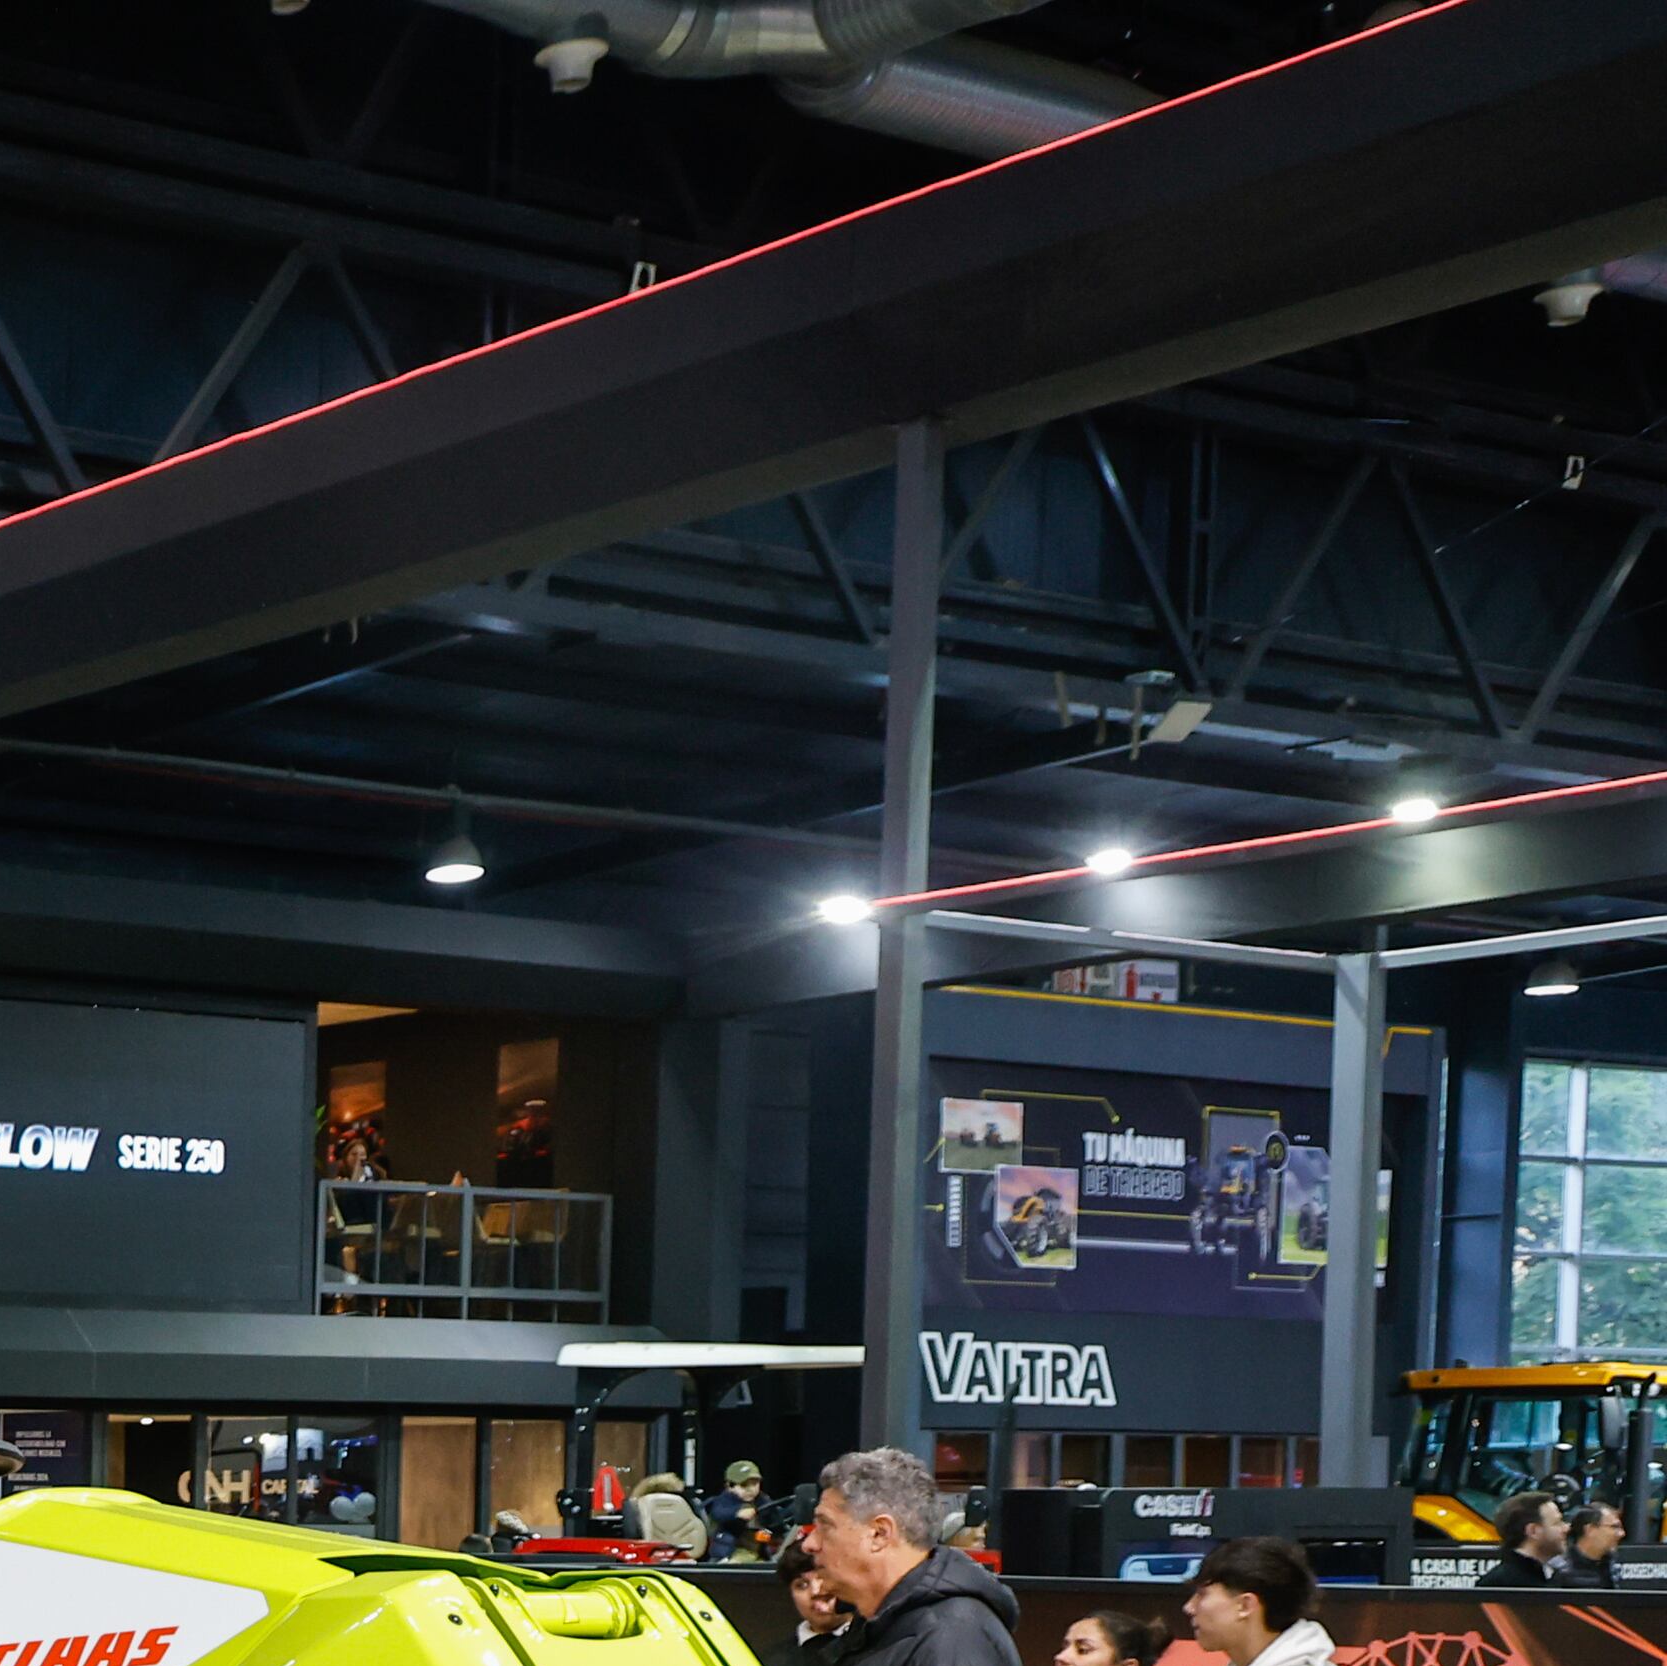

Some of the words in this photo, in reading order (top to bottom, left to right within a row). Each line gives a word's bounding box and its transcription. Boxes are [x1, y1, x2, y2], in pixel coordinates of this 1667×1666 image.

[118, 1134, 182, 1172] SERIE
[185, 1138, 225, 1174] 250
[1082, 1131, 1108, 1162] TU
[1109, 1127, 1186, 1168] MÁQUINA
[1082, 1165, 1108, 1196] DE
[1110, 1166, 1186, 1201] TRABAJO
[918, 1331, 1117, 1407] VALTRA
[1134, 1494, 1195, 1518] CASE
[1457, 1559, 1478, 1575] DE
